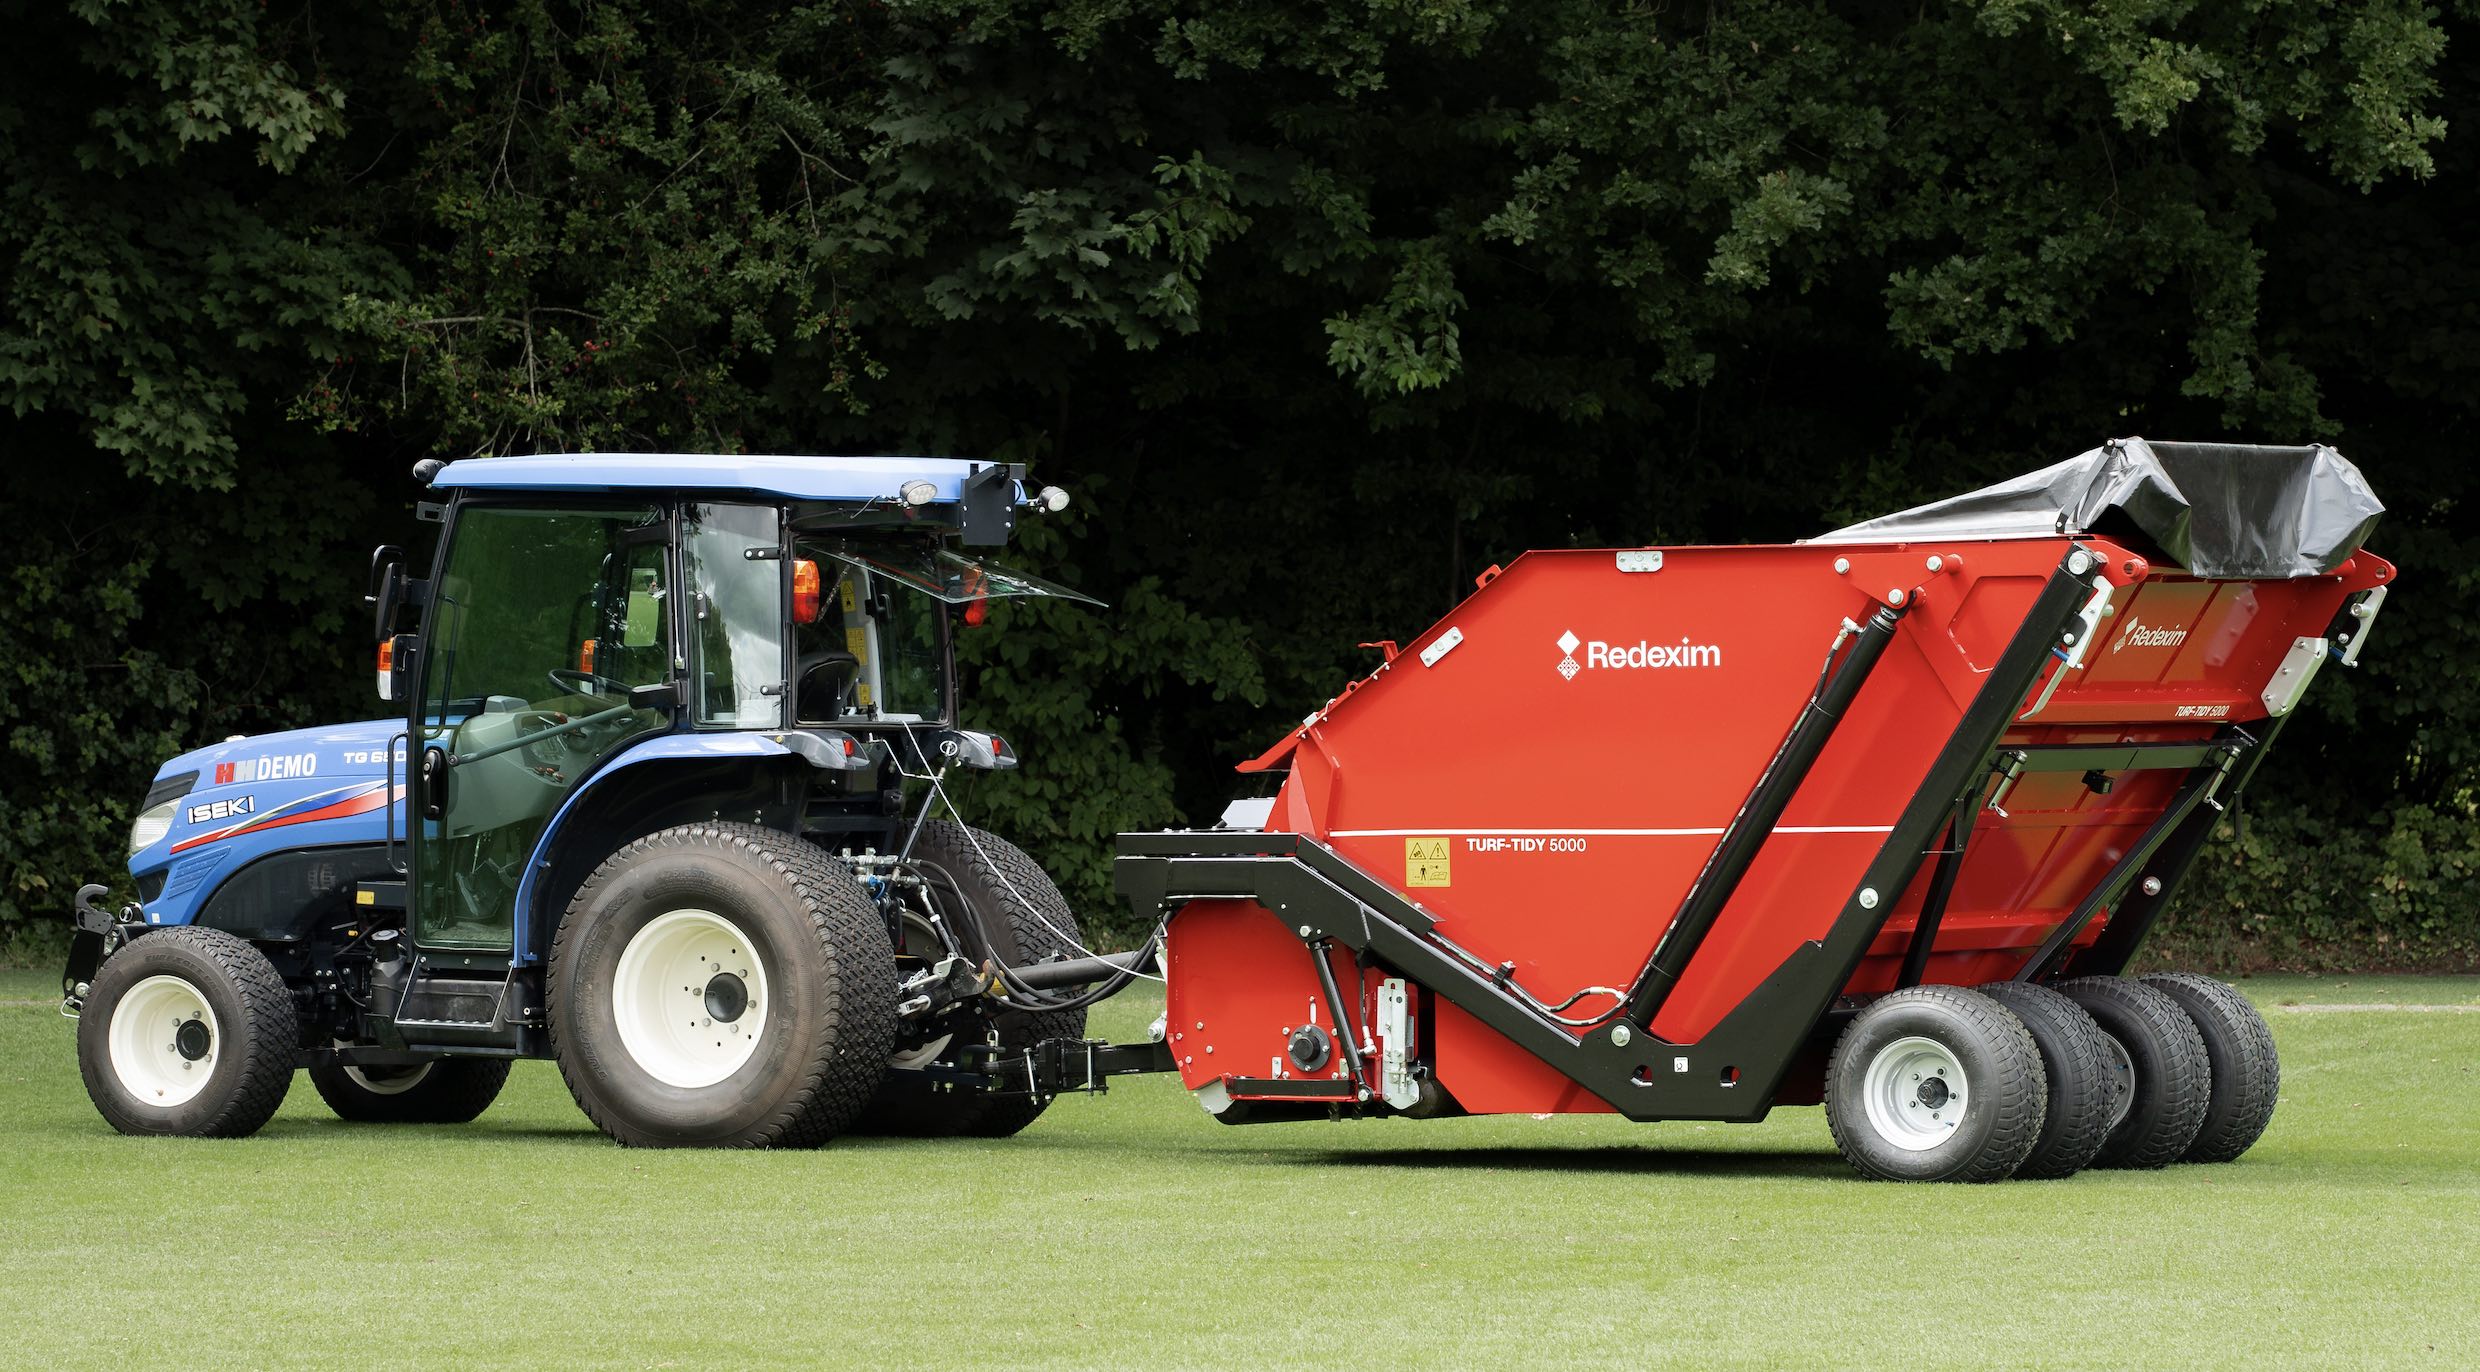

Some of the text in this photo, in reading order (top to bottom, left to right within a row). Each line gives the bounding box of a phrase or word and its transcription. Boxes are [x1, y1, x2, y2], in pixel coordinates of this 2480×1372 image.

[2127, 624, 2188, 647] Redexim
[1587, 636, 1721, 669] Redexim
[2175, 705, 2230, 717] TURF-TIDY 5000
[257, 752, 317, 781] DEMO
[343, 751, 368, 764] TG
[187, 795, 255, 825] ISEKI
[1466, 837, 1587, 852] TURF-TIDY 5000
